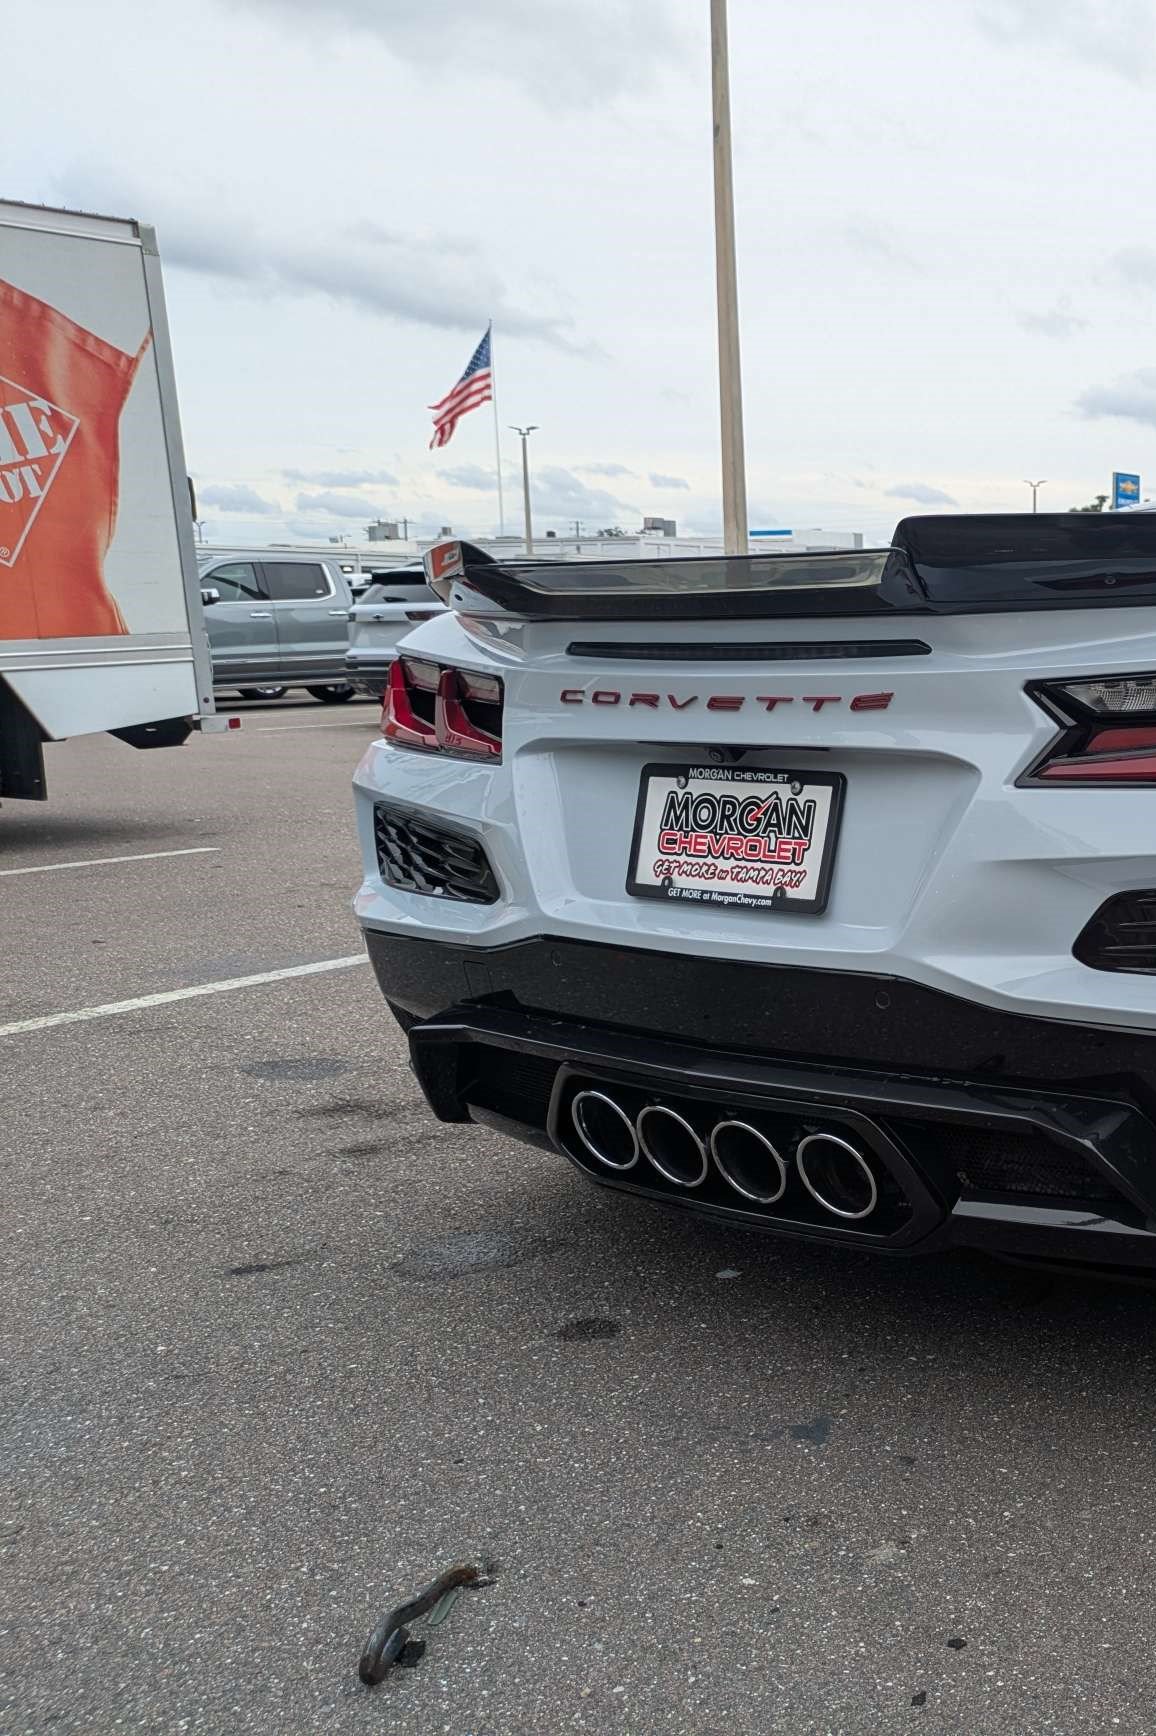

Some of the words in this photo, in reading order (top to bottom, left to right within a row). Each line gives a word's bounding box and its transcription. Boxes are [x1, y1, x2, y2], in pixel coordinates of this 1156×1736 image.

[560, 691, 894, 712] CORVETTE
[688, 767, 732, 780] MORGAN
[734, 772, 789, 782] CHEVROLET
[660, 791, 816, 840] MORGAN
[658, 830, 809, 864] CHEVROLET
[653, 859, 680, 878] GET
[678, 861, 718, 880] MORE
[731, 865, 774, 885] TAMPA
[668, 887, 681, 897] GET
[682, 889, 702, 899] MORE
[711, 892, 772, 906] MorganChevy.com
